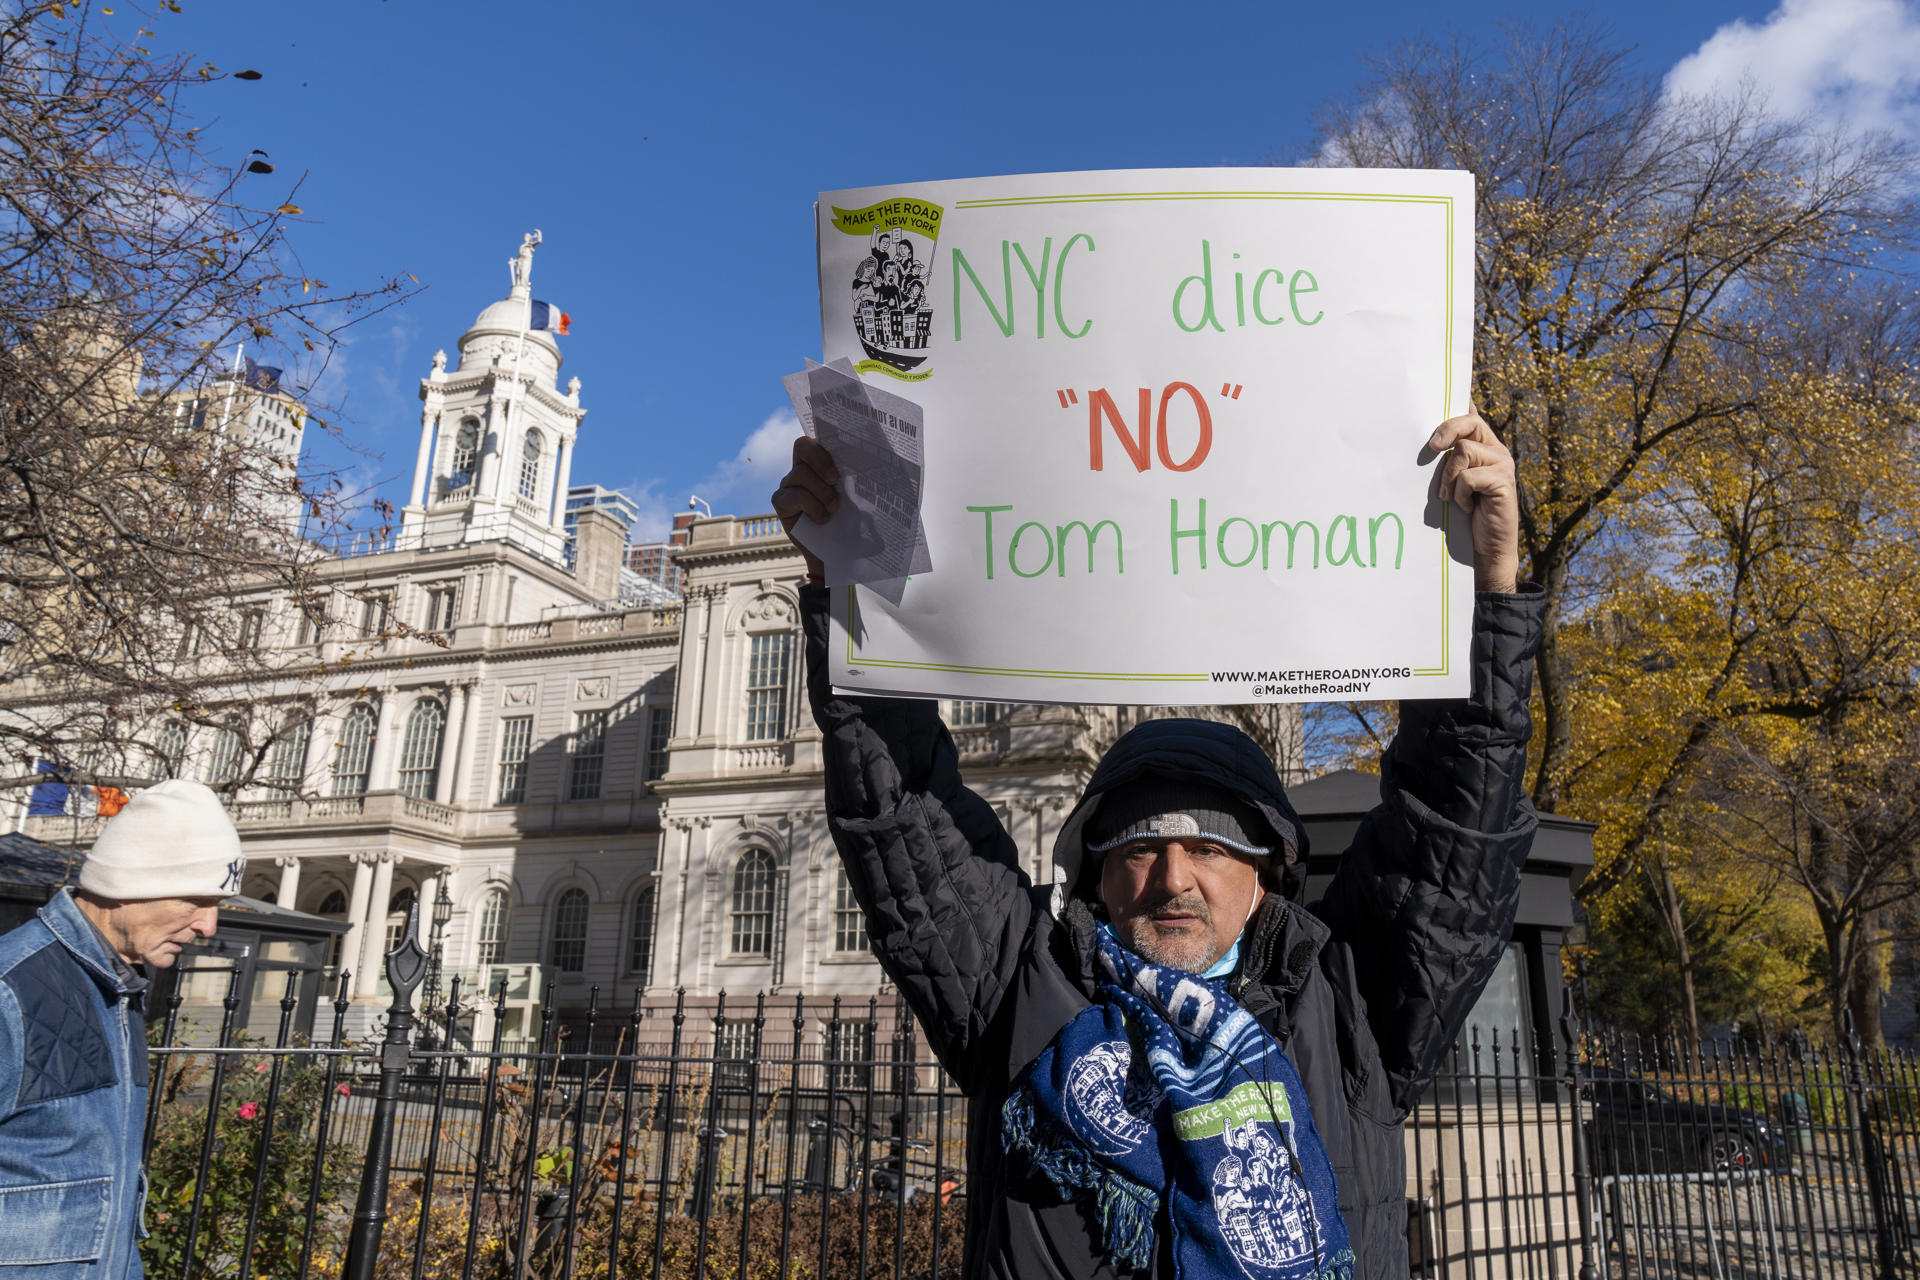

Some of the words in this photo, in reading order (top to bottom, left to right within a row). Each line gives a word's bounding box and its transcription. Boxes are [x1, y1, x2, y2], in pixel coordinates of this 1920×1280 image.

[842, 211, 875, 225] MAKE
[876, 203, 901, 218] THE
[904, 203, 940, 221] ROAD
[884, 216, 908, 227] NEW
[911, 217, 936, 233] YORK
[952, 233, 1095, 341] NYC
[1172, 239, 1324, 333] dice
[966, 504, 1124, 580] Tom
[1170, 498, 1404, 575] Homan
[1211, 667, 1411, 682] WWW.MAKETHEROADNY.ORG
[1252, 682, 1371, 697] @MaketheRoadNY
[1179, 1106, 1223, 1131] MAKE
[1221, 1090, 1249, 1111] THE
[1249, 1087, 1283, 1102] ROD
[1236, 1105, 1257, 1120] NEW
